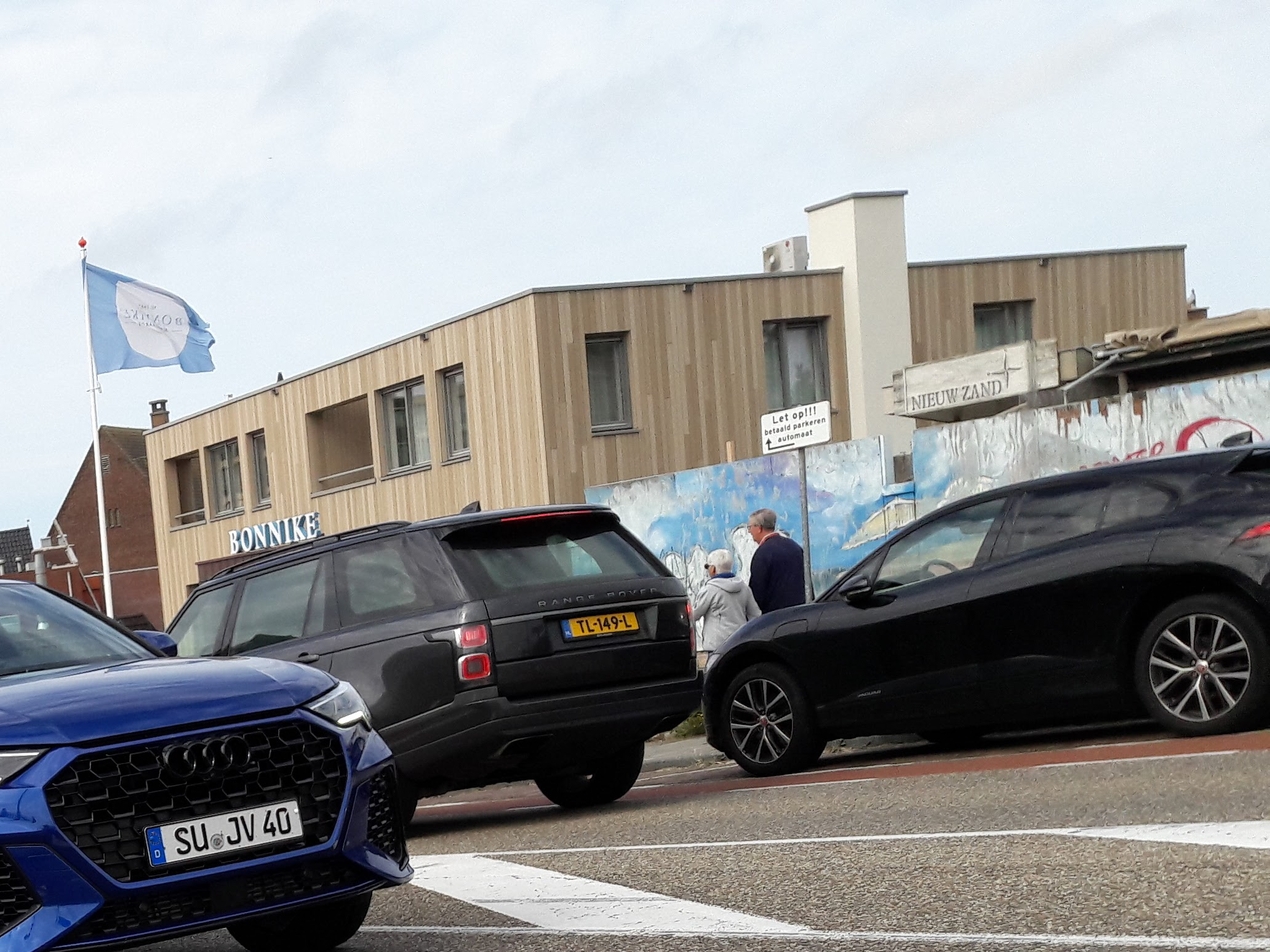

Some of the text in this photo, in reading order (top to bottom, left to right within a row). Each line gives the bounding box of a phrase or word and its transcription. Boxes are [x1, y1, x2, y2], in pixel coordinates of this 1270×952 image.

[911, 380, 1002, 411] NIEUW ZAND
[772, 406, 817, 424] Let op!!!
[764, 417, 826, 436] betaald parkeren
[777, 430, 813, 442] automaat
[229, 512, 322, 555] BONNIKE
[538, 594, 596, 607] RANGE
[576, 615, 632, 633] TL-149-L
[174, 807, 292, 855] SU JV 40
[154, 849, 161, 859] D
